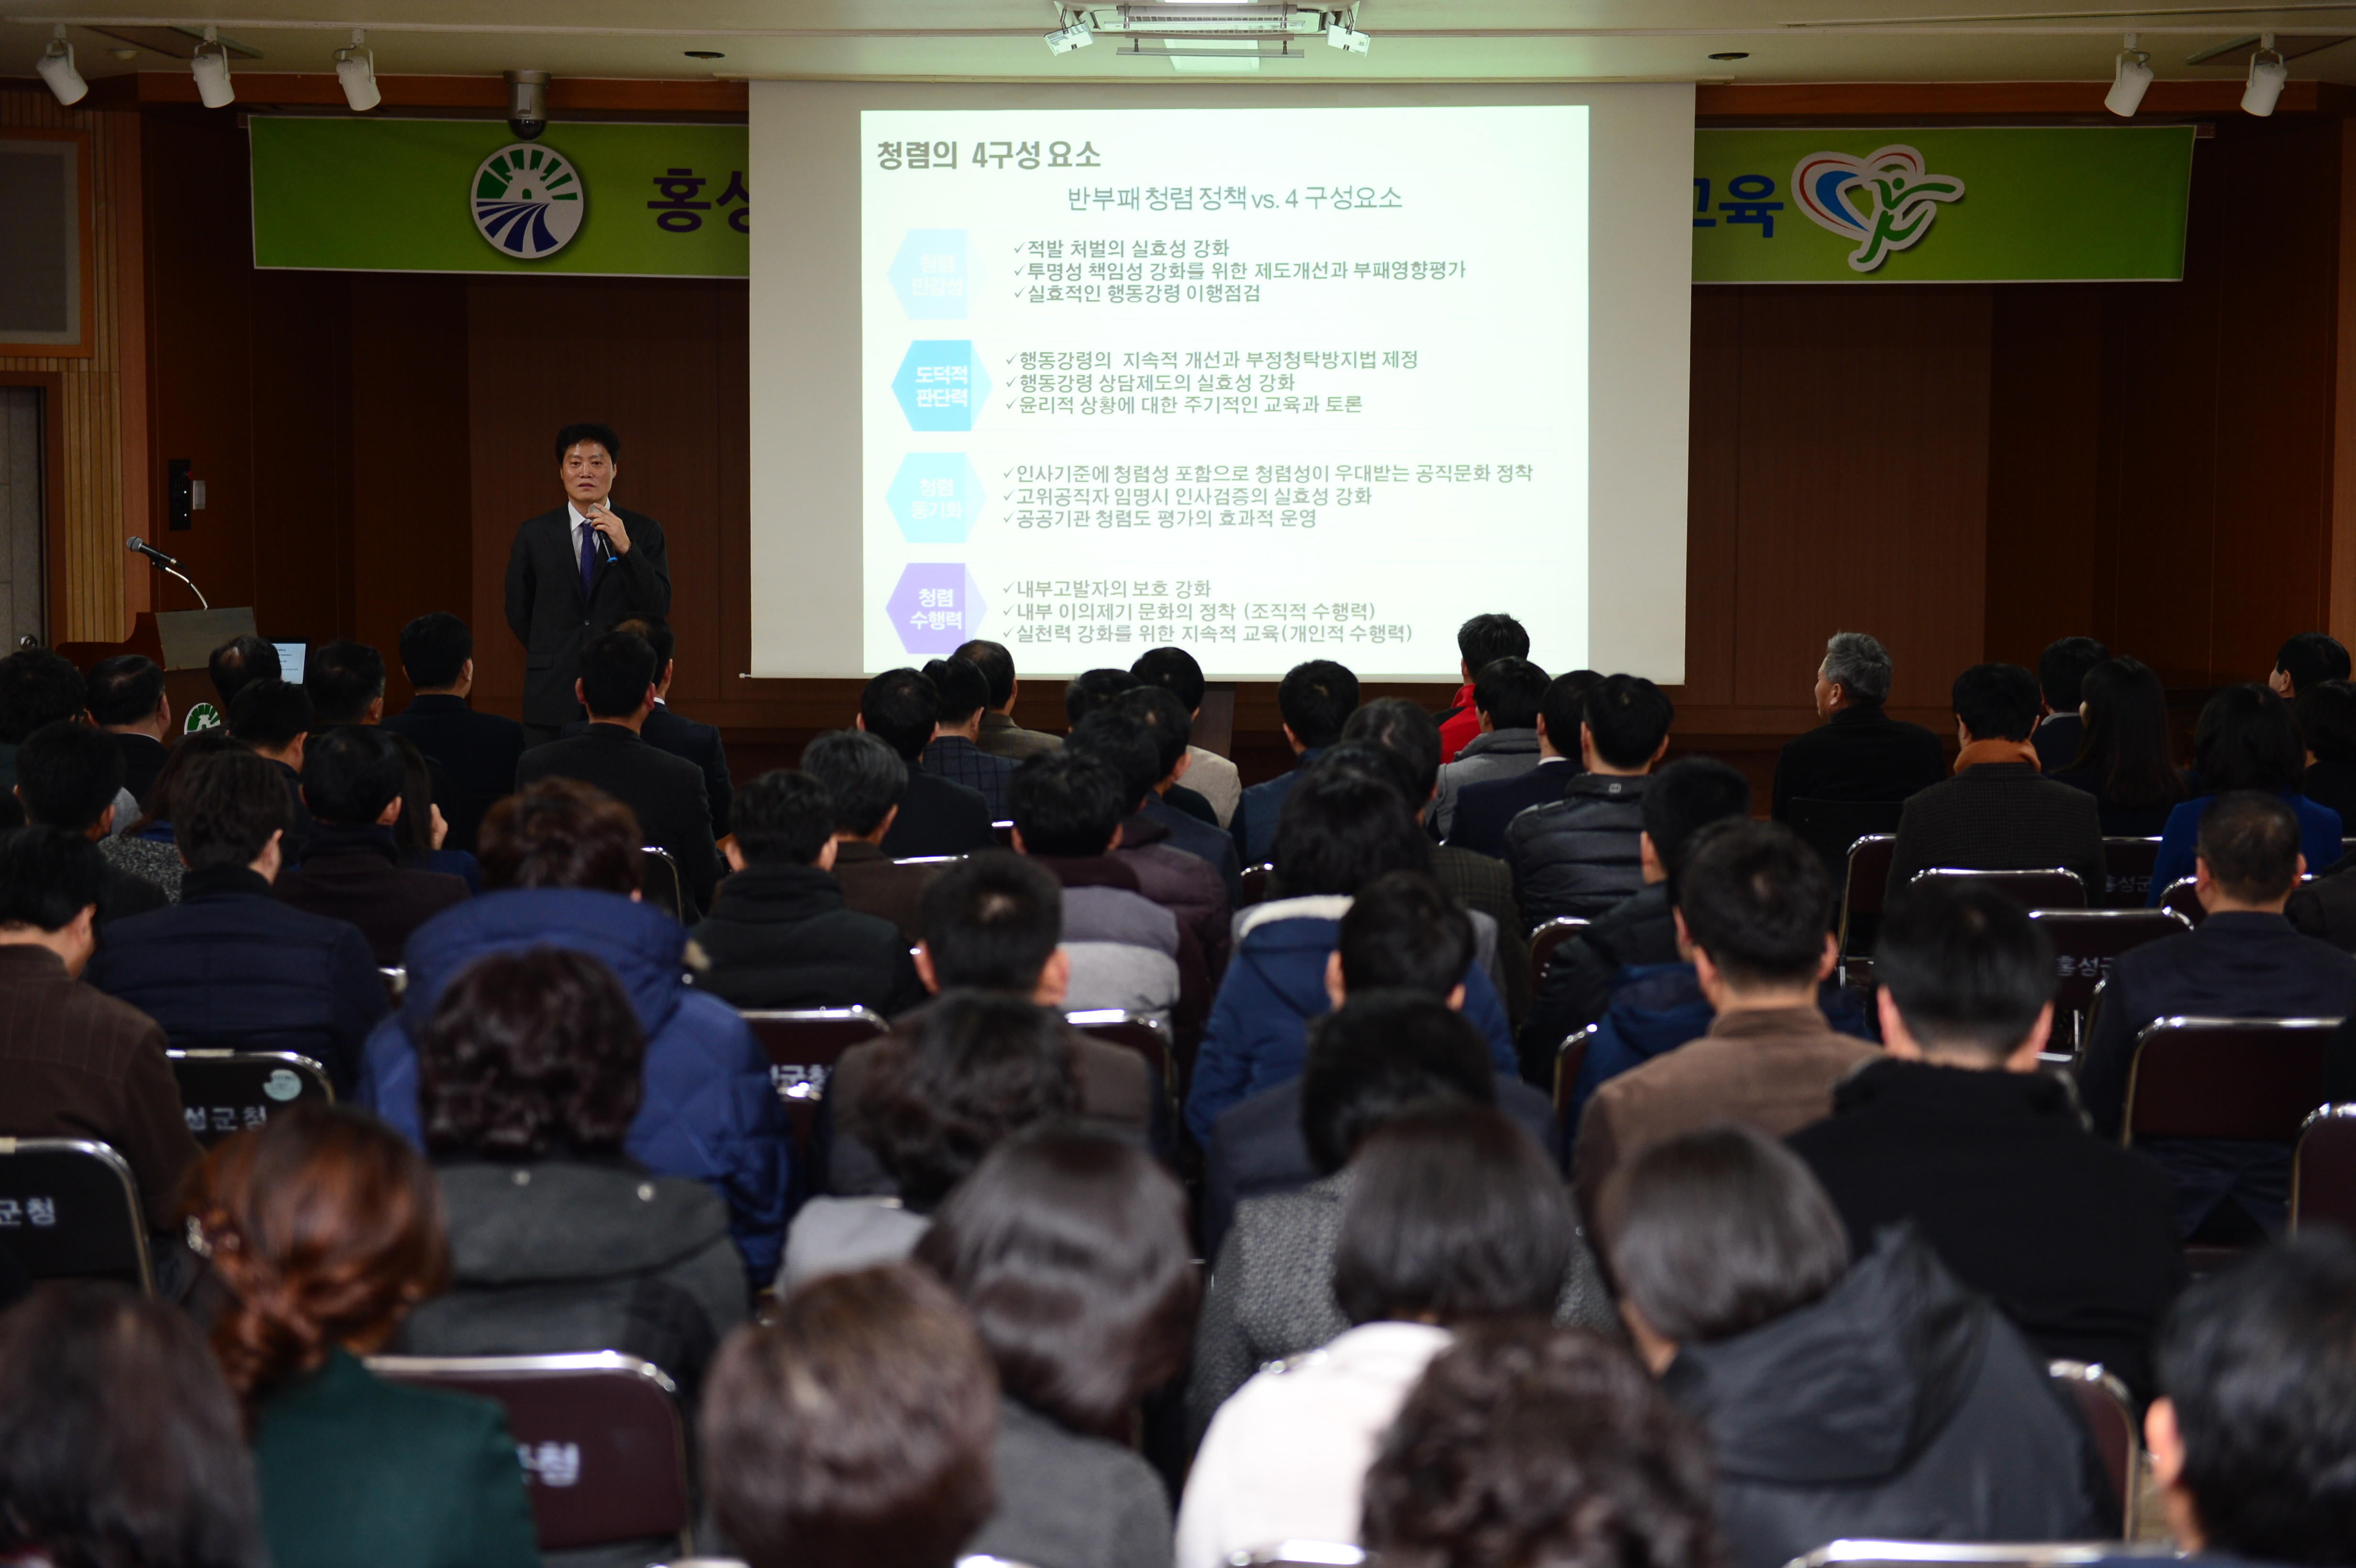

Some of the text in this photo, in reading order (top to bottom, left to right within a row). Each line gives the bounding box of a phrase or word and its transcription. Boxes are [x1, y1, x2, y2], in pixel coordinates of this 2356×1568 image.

[878, 142, 957, 170] 청렴의
[1069, 185, 1402, 211] 반부패 청렴 정책 vs. 4 구성요소
[1028, 239, 1229, 258] 적발 처벌의 실효성 강화
[919, 254, 955, 273] 청렴
[1028, 261, 1466, 282] 투명성 책임성 강화를 위한 제도개선과 부패영향평가
[912, 277, 963, 296] 민감성
[1028, 284, 1259, 303] 실효적인 행동강령 이행점검
[1020, 350, 1417, 370] 행동강령의 지속적 개선과 부정청탁방지법 제정
[916, 366, 968, 384] 도덕적
[1020, 373, 1295, 393] 행동강령 상담제도의 실효성 강화
[916, 388, 968, 407] 판단력
[1019, 395, 1362, 415] 윤리적 상황에 대한 주기적인 교육과 토론
[1017, 464, 1533, 484] 인사기준에 청렴성 포함으로 청렴성이 우대받는 공직문화 정착
[919, 478, 954, 497] 청렴
[1017, 487, 1372, 506] 고위공직자 임명시 인사검증의 실효성 강화
[910, 501, 963, 520] 동기화
[1017, 509, 1315, 528] 공공기관 청렴도 평가의 효과적 운영
[919, 588, 953, 607] 청렴
[1018, 580, 1211, 599] 내부고발자의 보호 강화
[910, 611, 962, 630] 수행력
[1018, 603, 1374, 621] 내부 이의제기 문화의 정착 (조직적 수행력)
[1017, 624, 1412, 643] 실천력 강화를 위한 지속적 교육(개인적 수행력)
